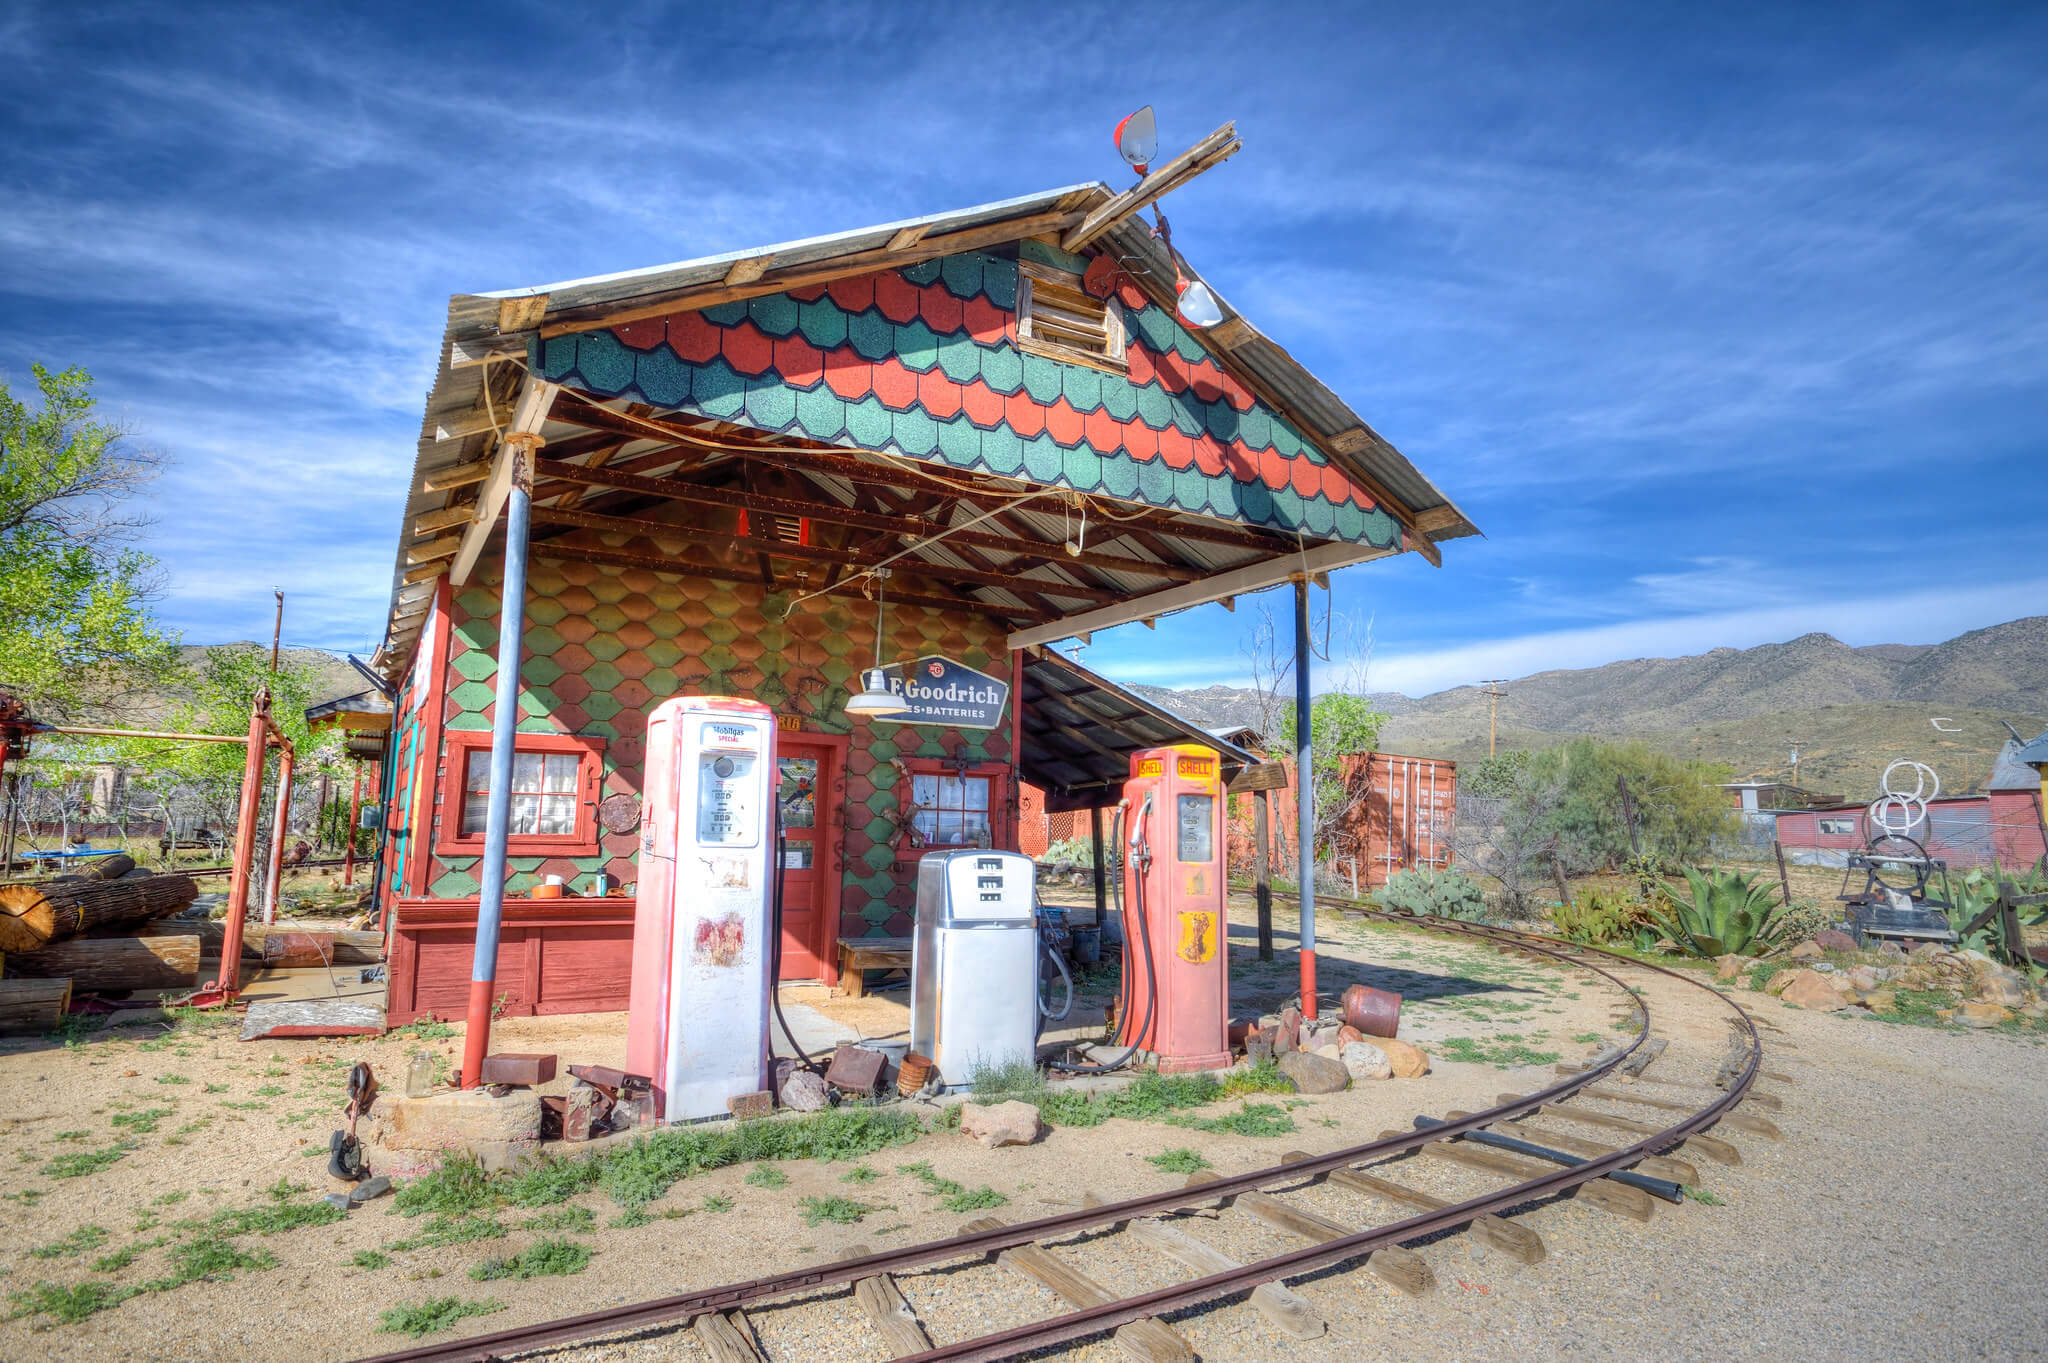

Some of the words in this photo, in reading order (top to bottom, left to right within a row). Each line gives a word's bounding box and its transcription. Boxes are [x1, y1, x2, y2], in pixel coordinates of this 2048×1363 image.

[889, 677, 1000, 705] F.Goodrich
[926, 706, 985, 718] BATTERIES
[1180, 760, 1209, 775] SHELL
